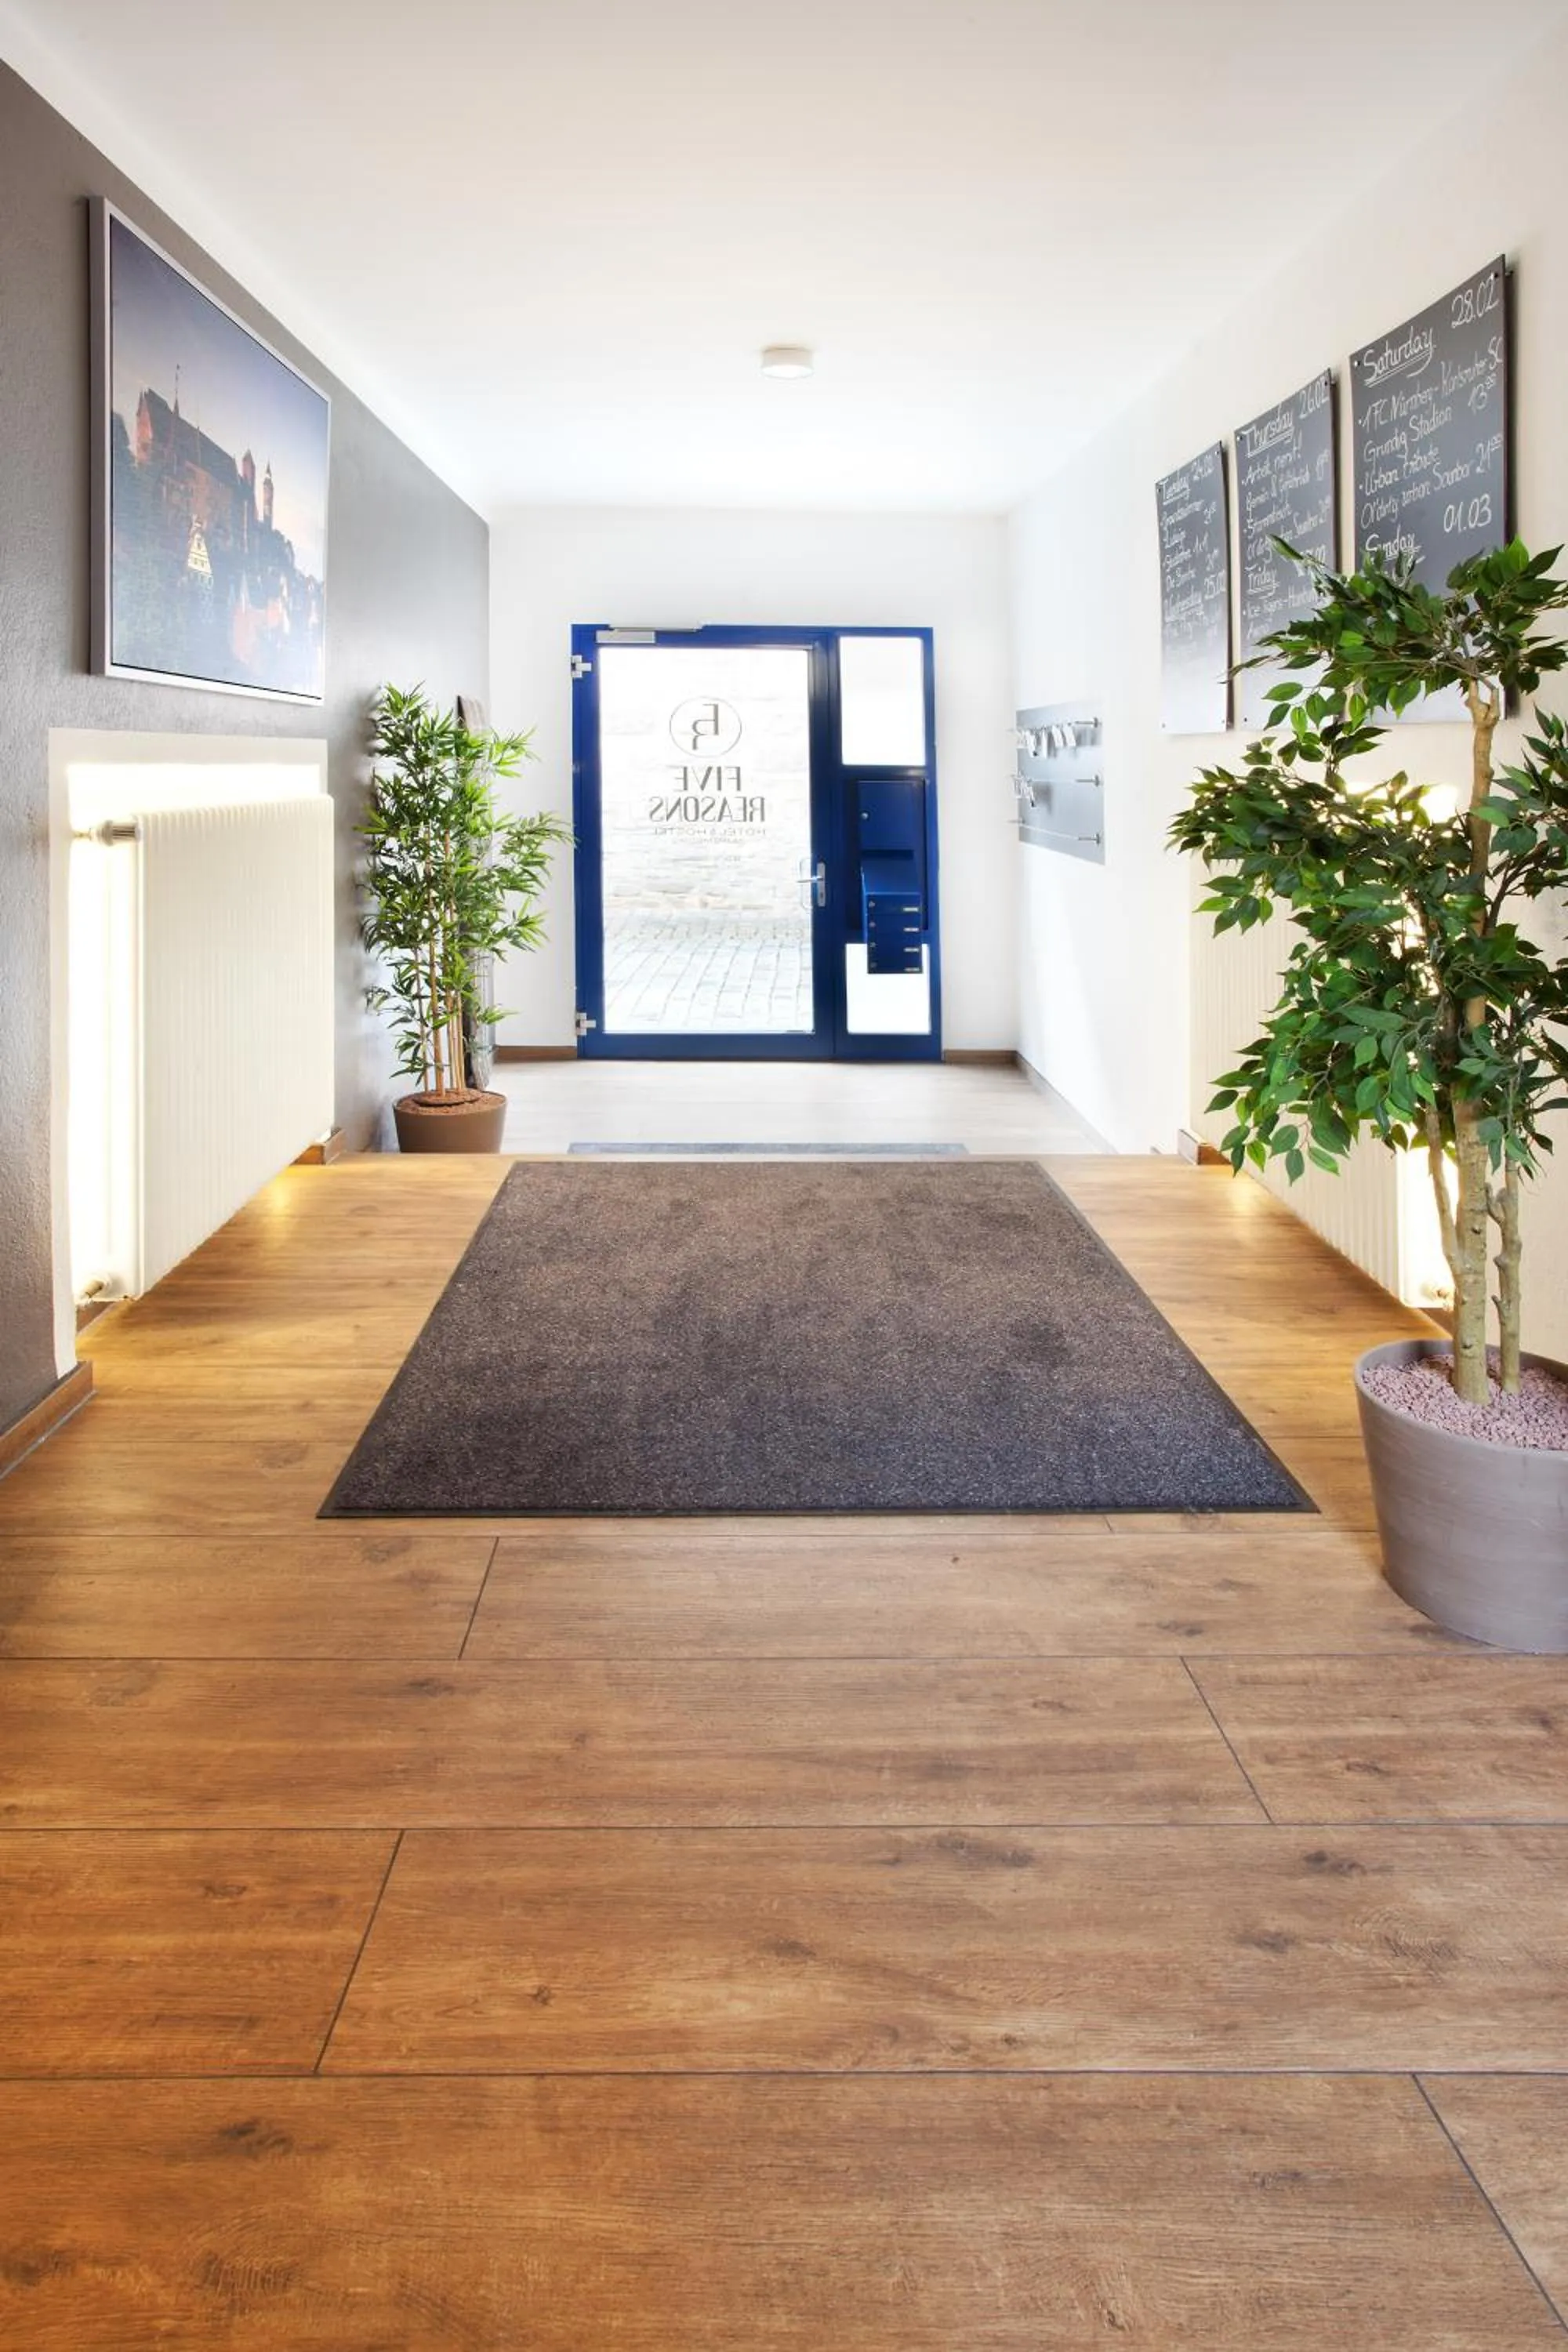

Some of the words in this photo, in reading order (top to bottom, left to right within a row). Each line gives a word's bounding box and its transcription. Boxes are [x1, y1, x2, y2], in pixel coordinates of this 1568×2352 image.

[1451, 278, 1499, 328] 28.02
[1488, 336, 1503, 371] SC
[1410, 403, 1452, 441] Stadion
[1443, 493, 1492, 535] 01.03
